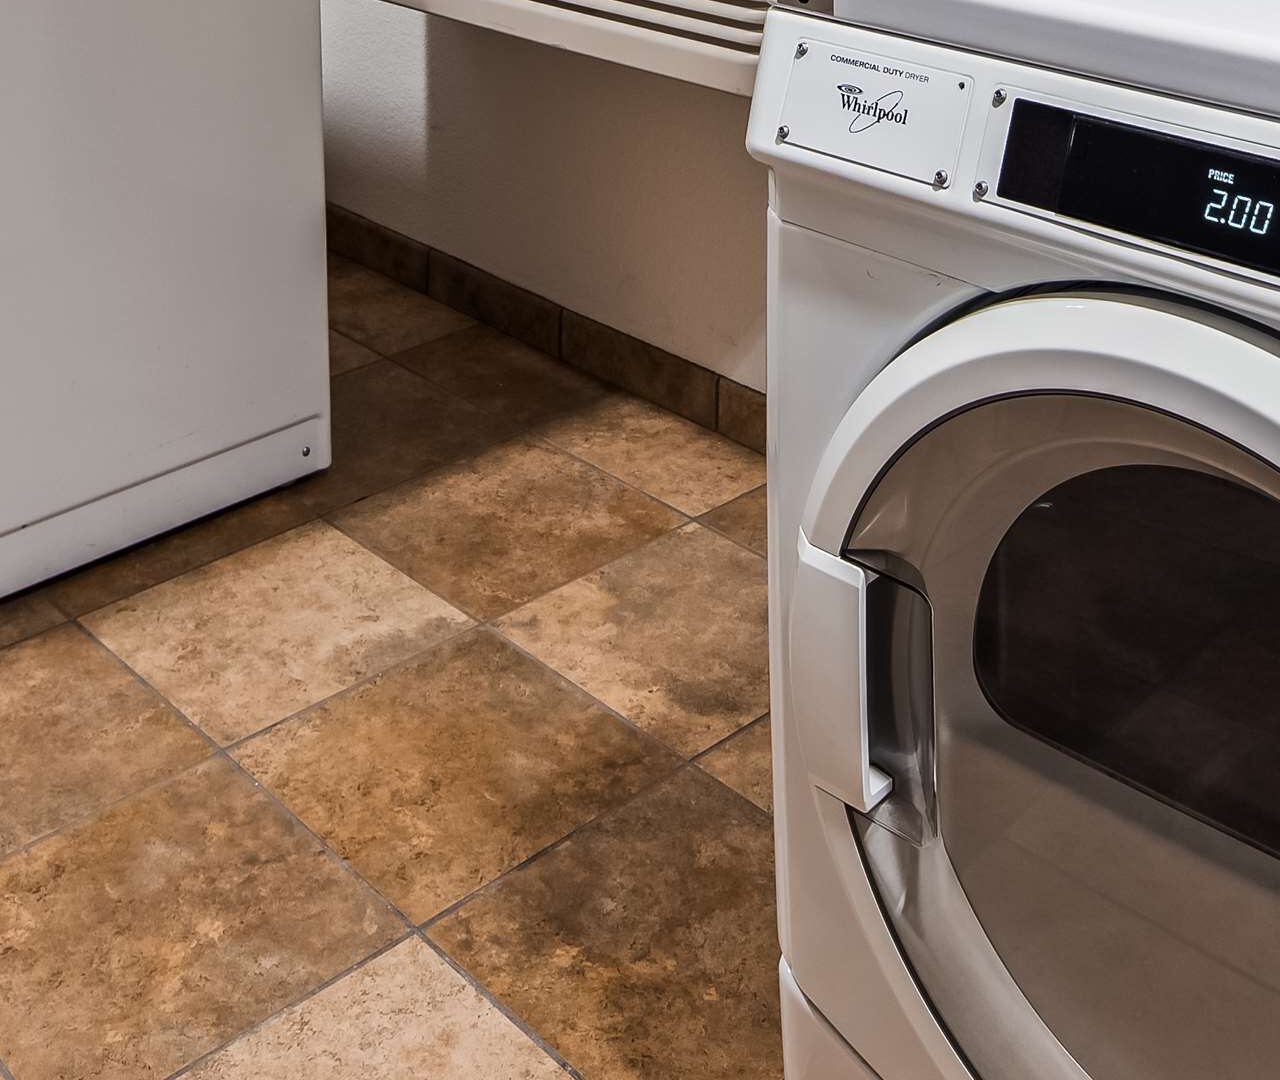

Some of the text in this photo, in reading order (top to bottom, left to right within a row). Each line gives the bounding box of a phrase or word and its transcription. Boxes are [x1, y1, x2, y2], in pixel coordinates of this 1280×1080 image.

[830, 54, 930, 84] COMMERCIAL DUTY DRYER
[840, 92, 909, 125] Whirlpool
[1207, 168, 1235, 185] PRICE
[1204, 188, 1274, 235] 2.00
